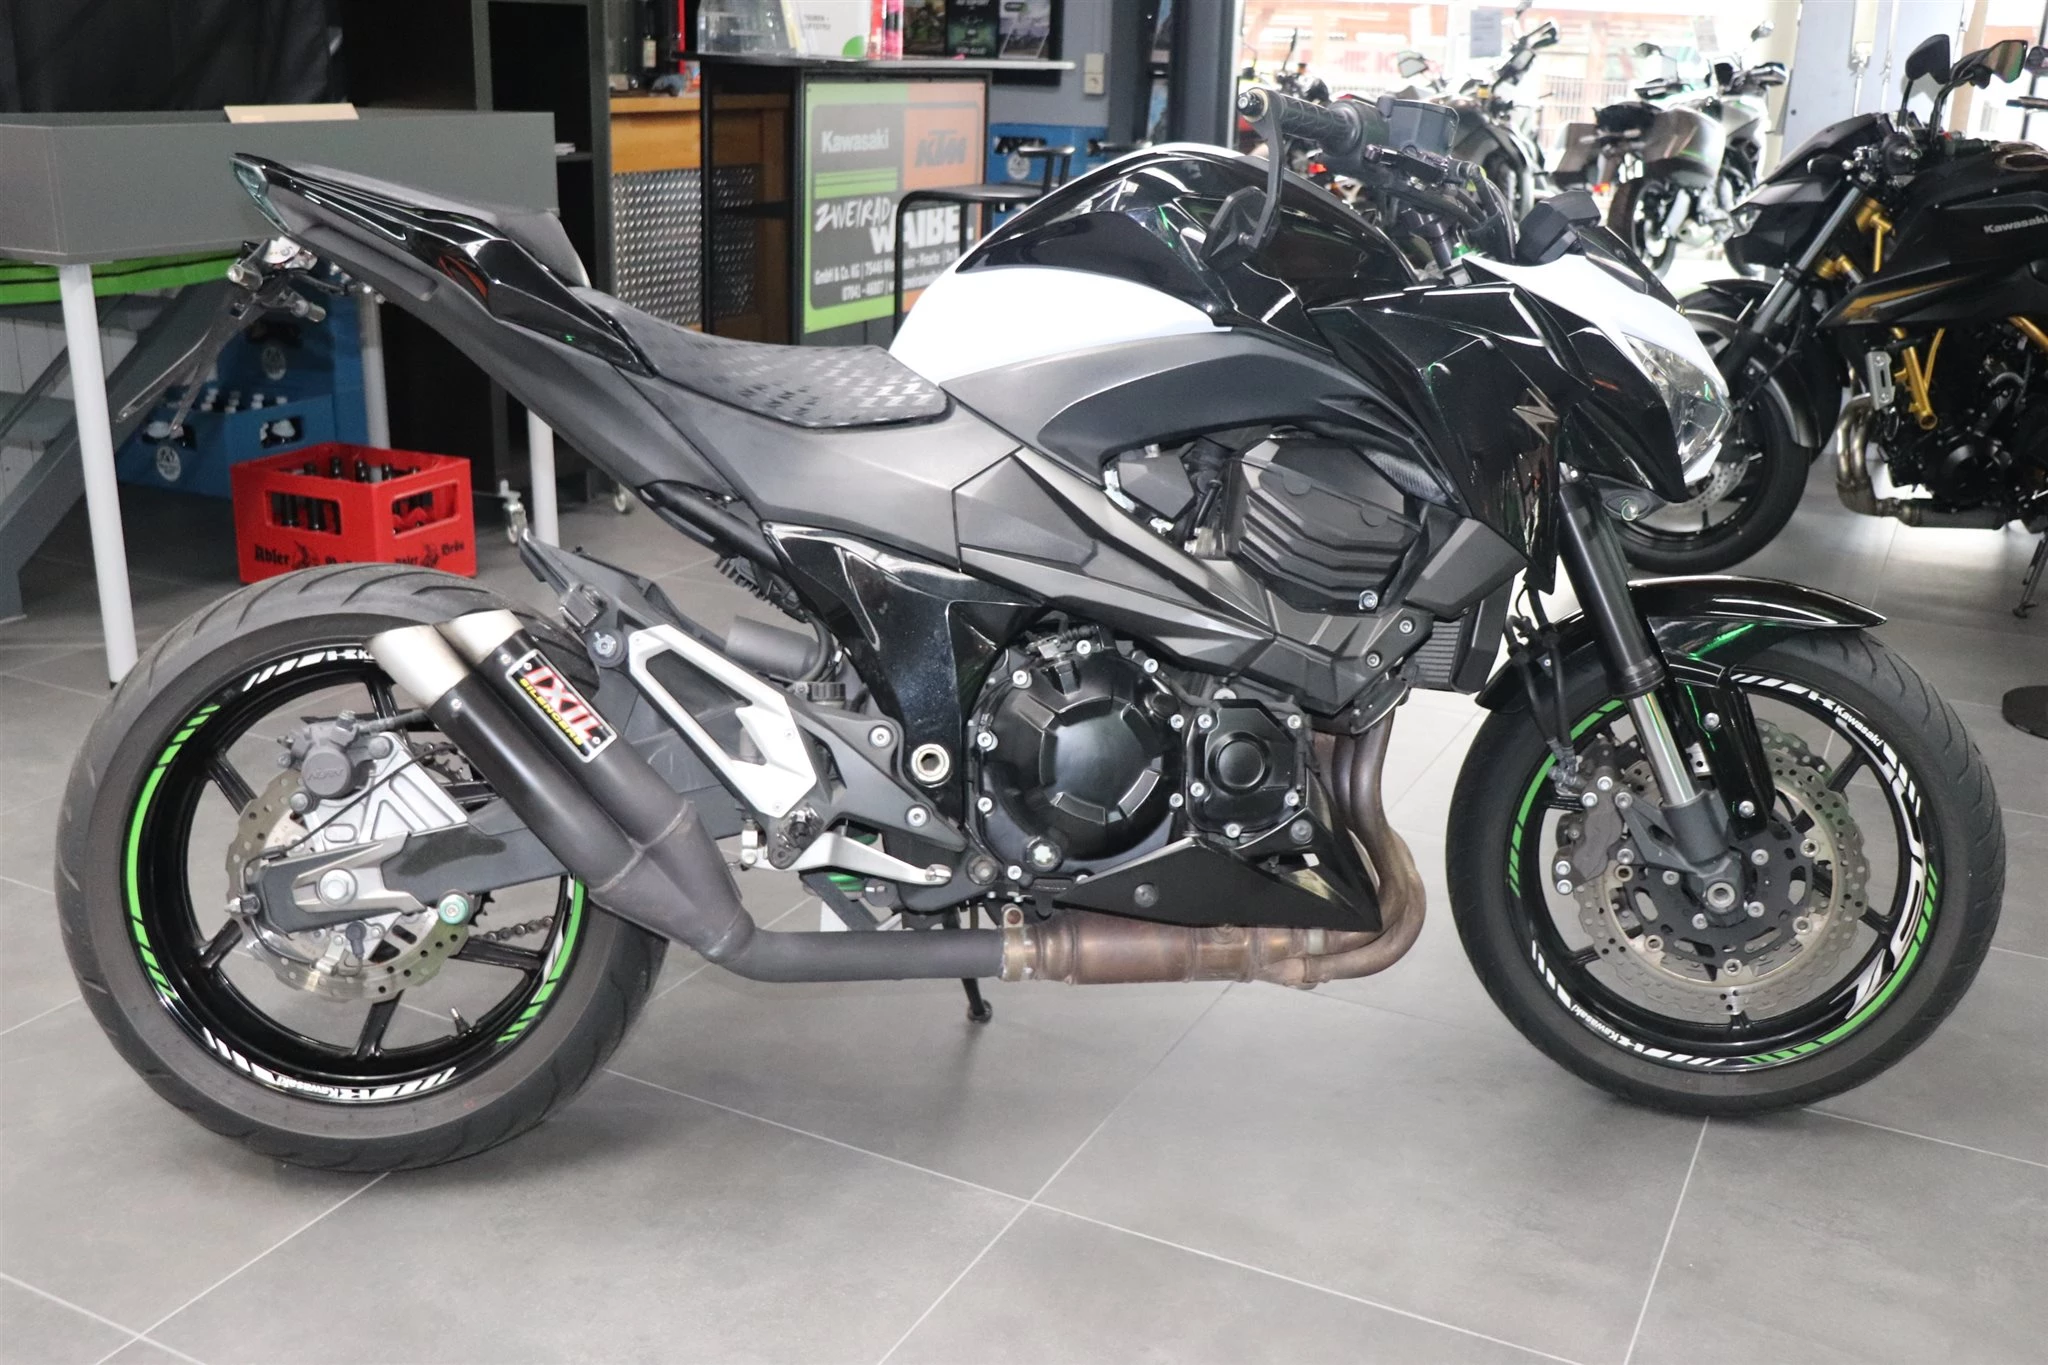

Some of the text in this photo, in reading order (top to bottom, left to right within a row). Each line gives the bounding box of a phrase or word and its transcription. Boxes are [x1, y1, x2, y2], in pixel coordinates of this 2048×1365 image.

[822, 128, 890, 154] Kawasaki
[915, 129, 968, 168] KTM
[869, 204, 974, 254] WAIBE
[1983, 214, 2048, 234] Kawasaki
[1833, 705, 1884, 747] Kawasaki
[1570, 1004, 1620, 1042] Kawasaki
[276, 1075, 342, 1100] Kawasaki
